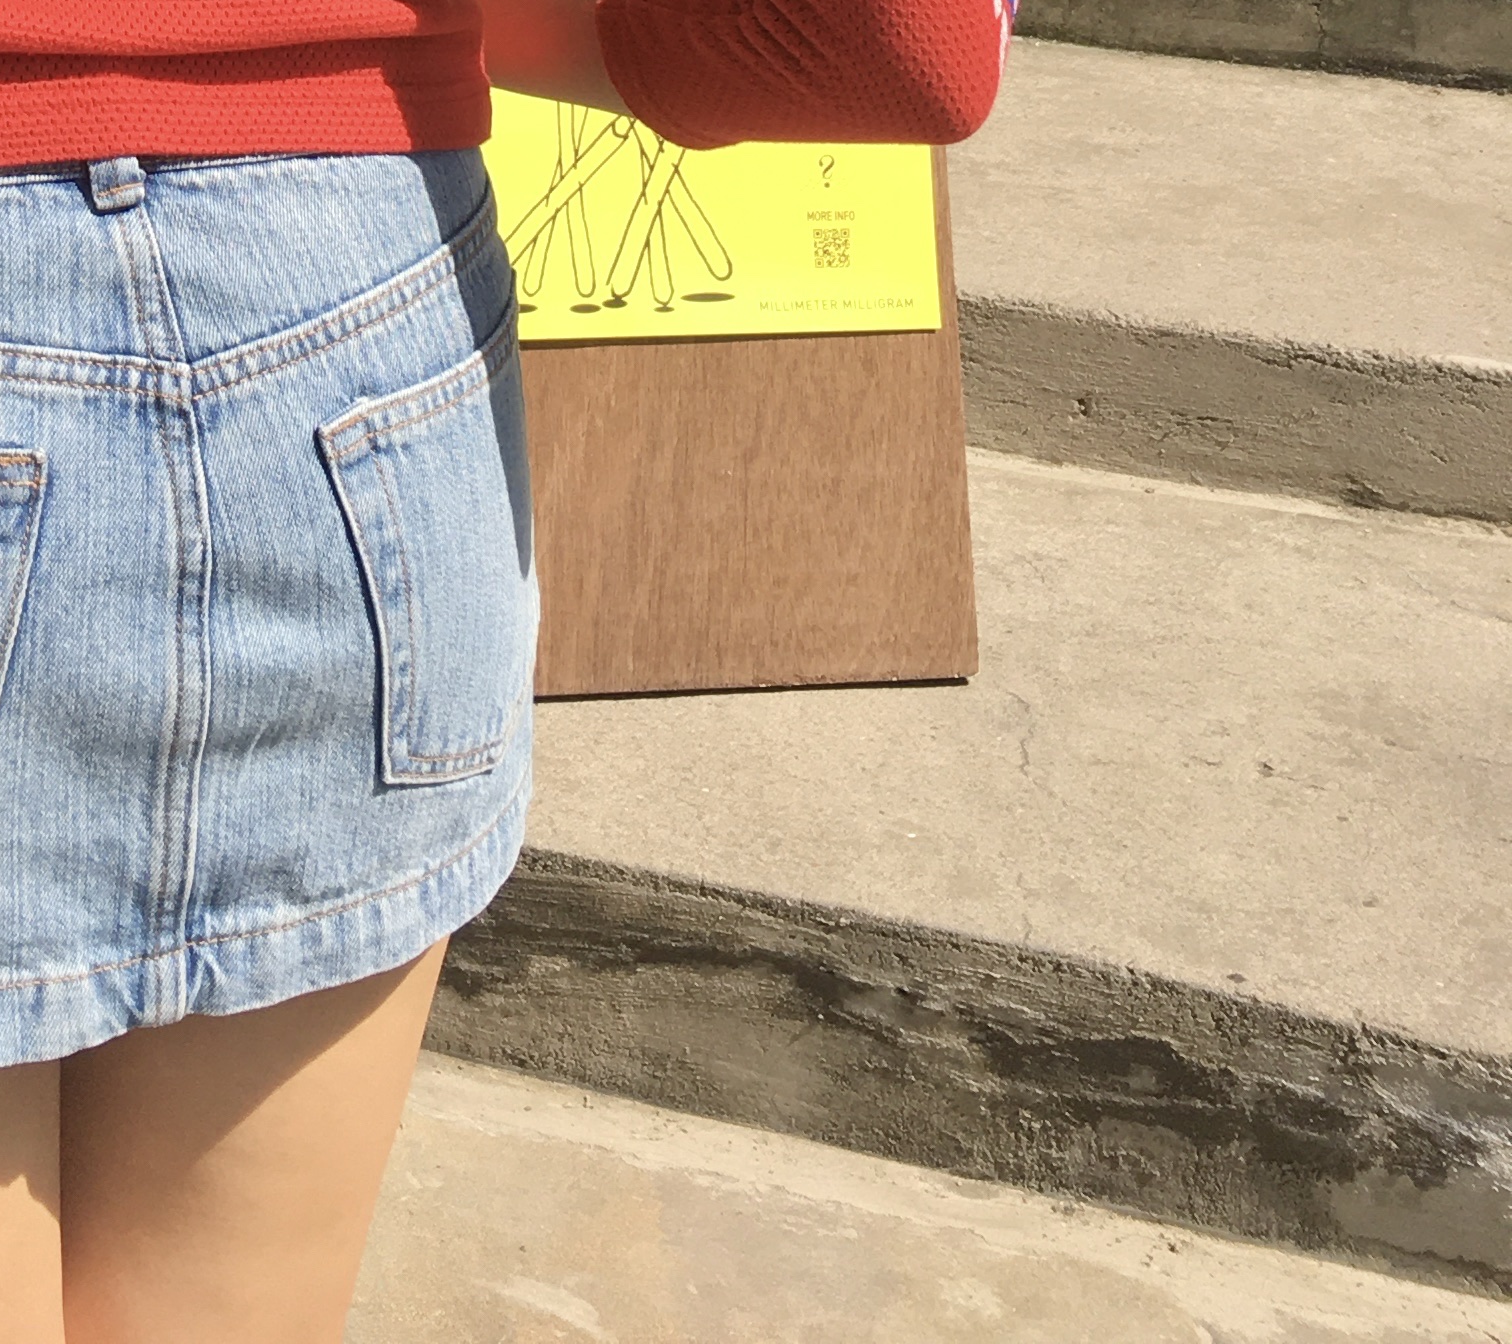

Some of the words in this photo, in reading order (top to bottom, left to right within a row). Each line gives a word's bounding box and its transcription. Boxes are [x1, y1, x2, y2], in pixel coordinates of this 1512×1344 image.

[806, 210, 833, 222] MORE
[834, 210, 856, 221] INFO
[759, 299, 838, 312] MILLIMETER
[842, 297, 915, 310] MILLIGRAM
